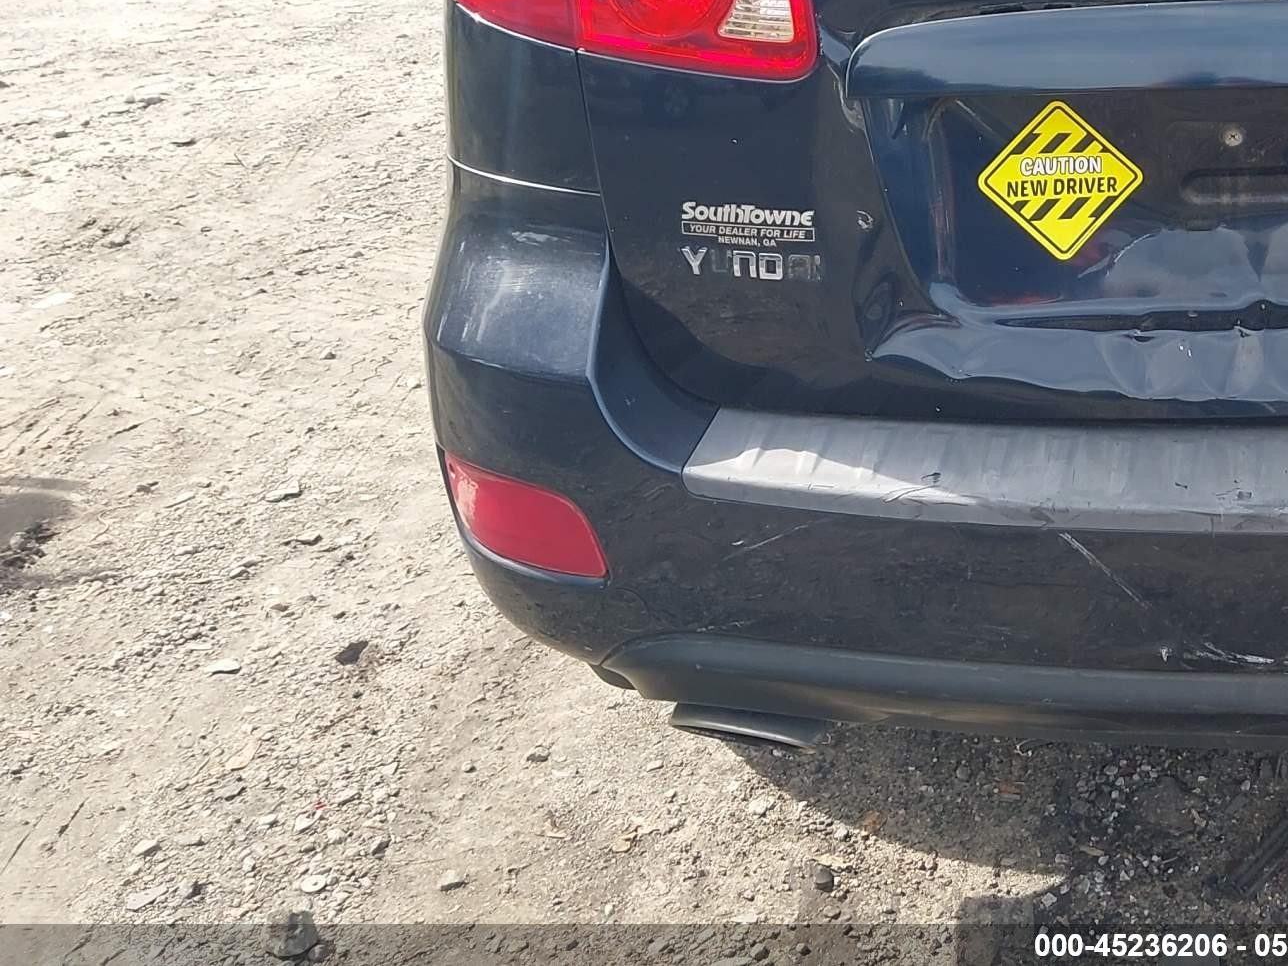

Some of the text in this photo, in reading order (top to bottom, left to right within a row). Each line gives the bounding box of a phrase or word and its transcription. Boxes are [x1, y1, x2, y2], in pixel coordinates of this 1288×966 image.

[1020, 156, 1103, 176] CAUTION
[1006, 176, 1118, 198] NEW DRIVER
[689, 223, 806, 240] YOUR DEALER FOR LIFE
[718, 235, 777, 247] NEWNAN, GA
